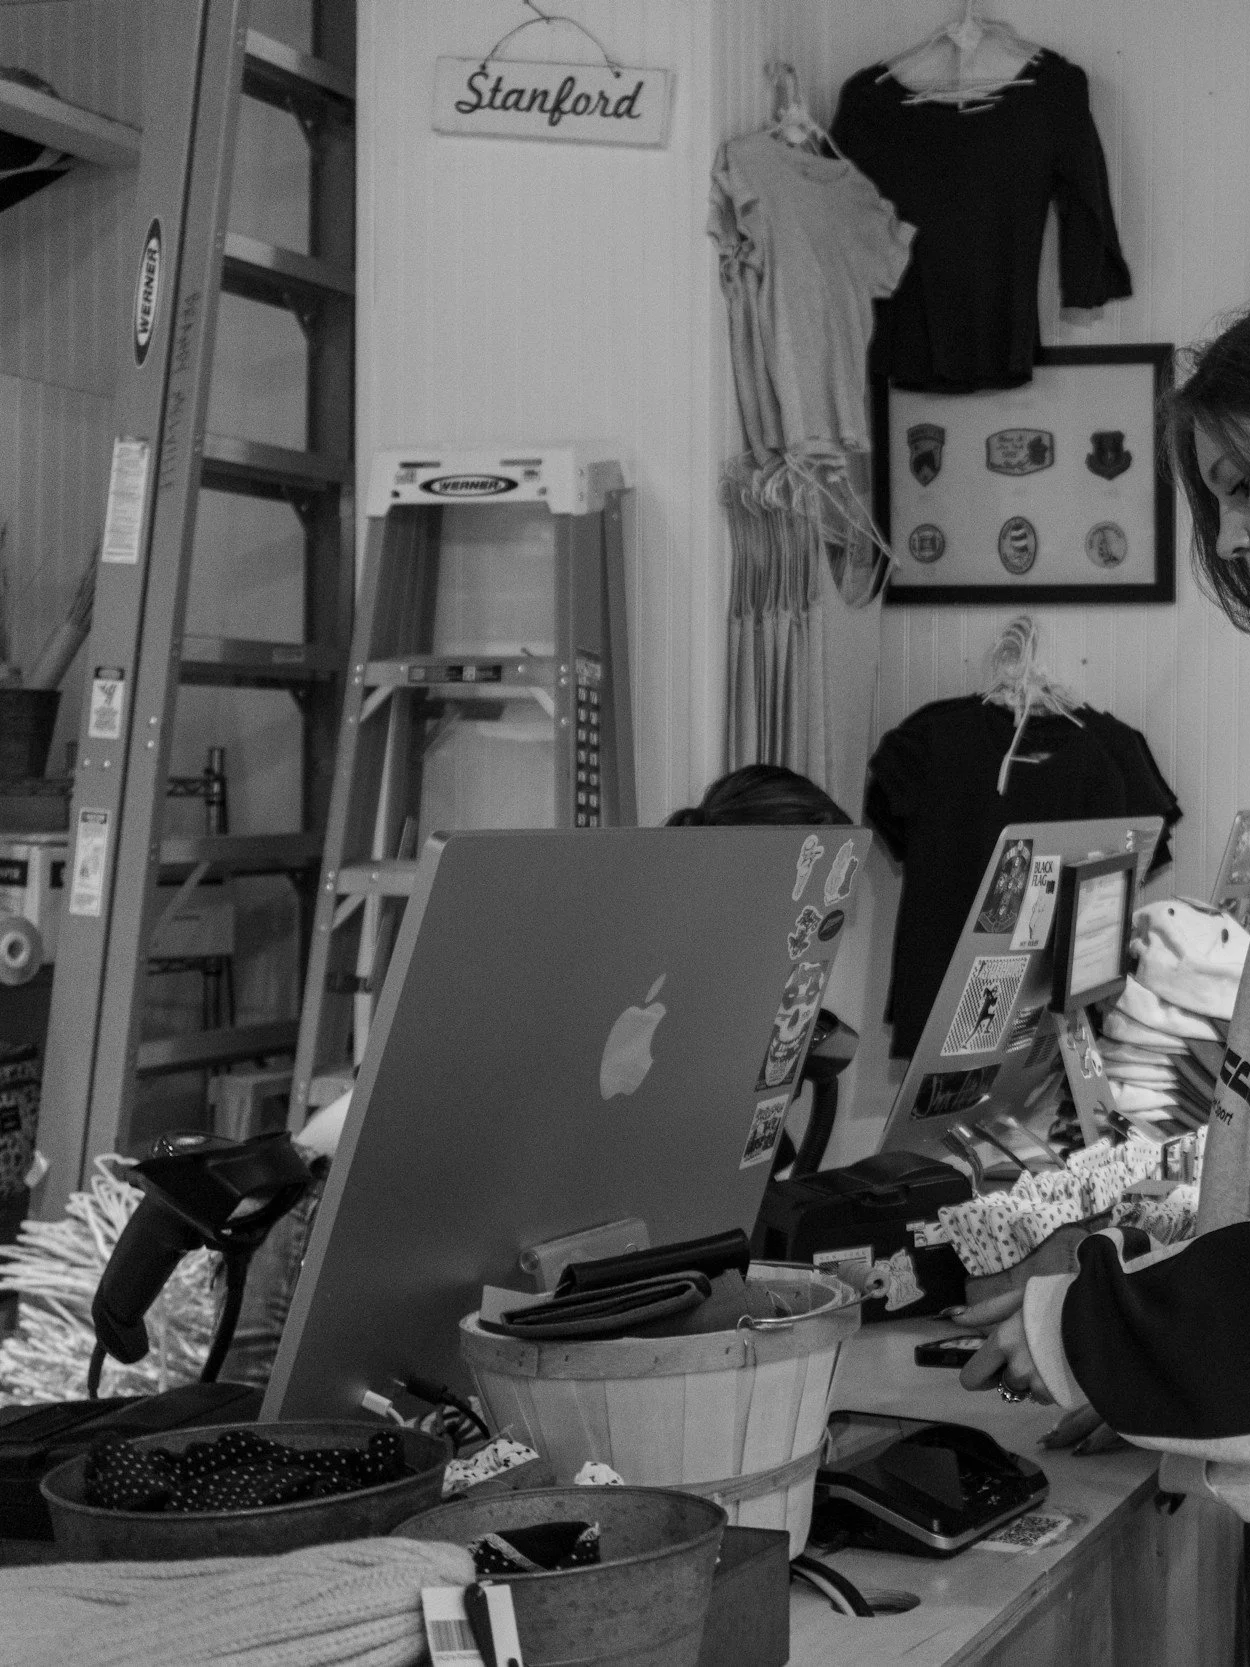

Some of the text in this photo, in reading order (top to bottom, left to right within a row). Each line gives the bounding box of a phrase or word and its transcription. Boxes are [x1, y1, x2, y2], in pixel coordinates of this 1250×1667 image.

[454, 71, 645, 127] Stanford
[139, 248, 158, 334] WERNER
[441, 480, 499, 491] WERNER
[1034, 861, 1053, 873] BLACK
[1031, 874, 1047, 886] FLAG
